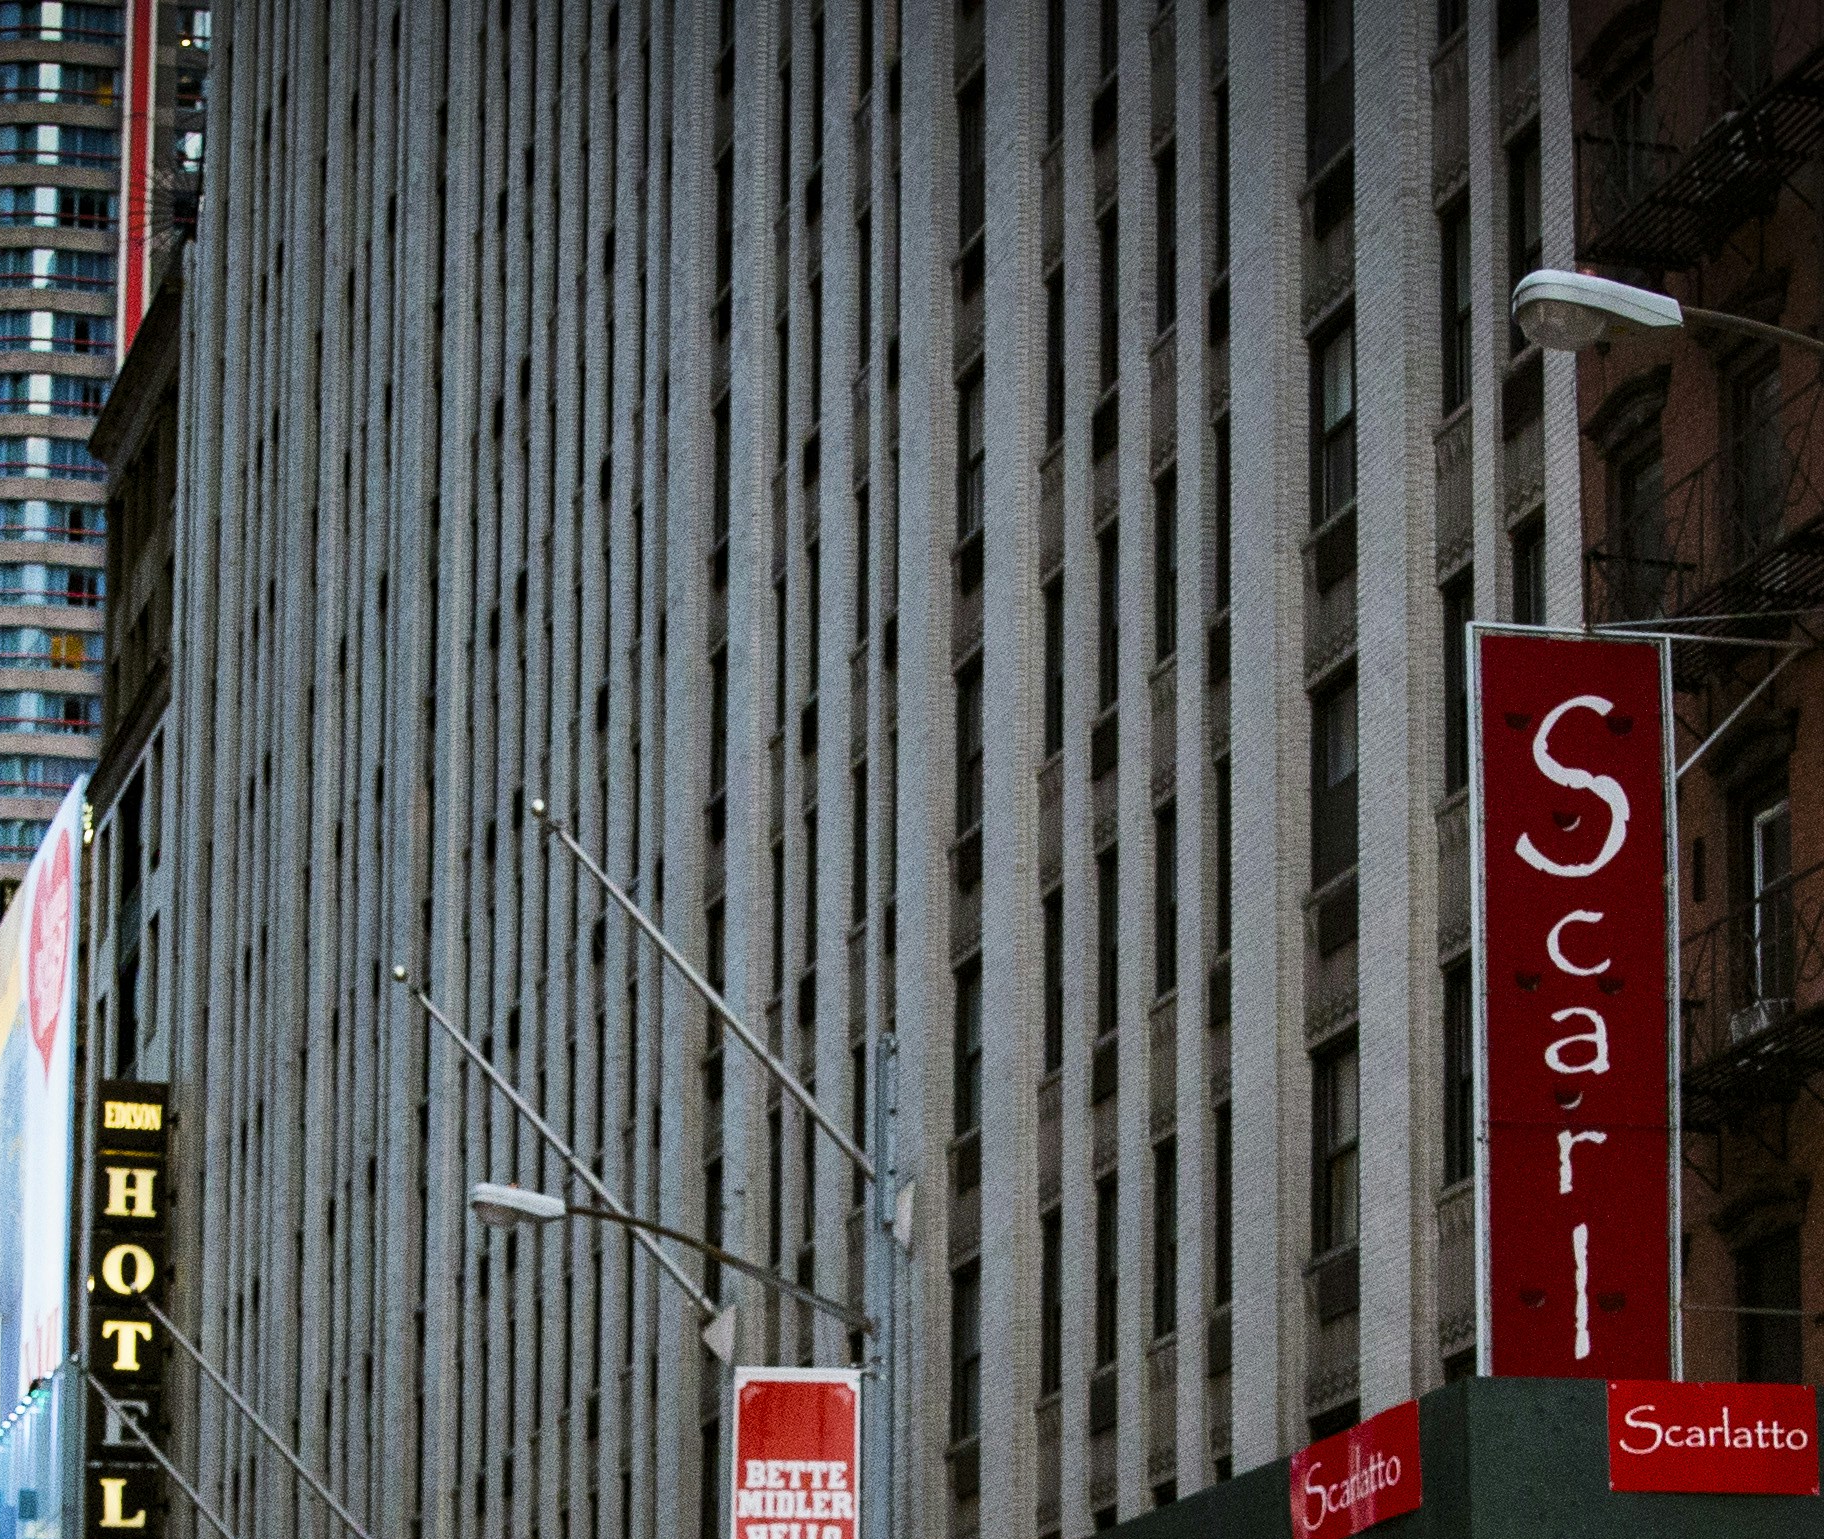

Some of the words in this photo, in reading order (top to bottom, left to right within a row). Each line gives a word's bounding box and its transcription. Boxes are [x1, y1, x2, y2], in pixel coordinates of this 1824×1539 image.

[1515, 695, 1630, 1359] Scarl
[103, 1101, 163, 1131] EDISON
[101, 1165, 158, 1529] HOTEL
[1619, 1404, 1809, 1455] Scarlatto
[745, 1460, 847, 1490] BETTE
[1302, 1447, 1403, 1533] Scarlatto
[739, 1489, 855, 1520] MIDLER
